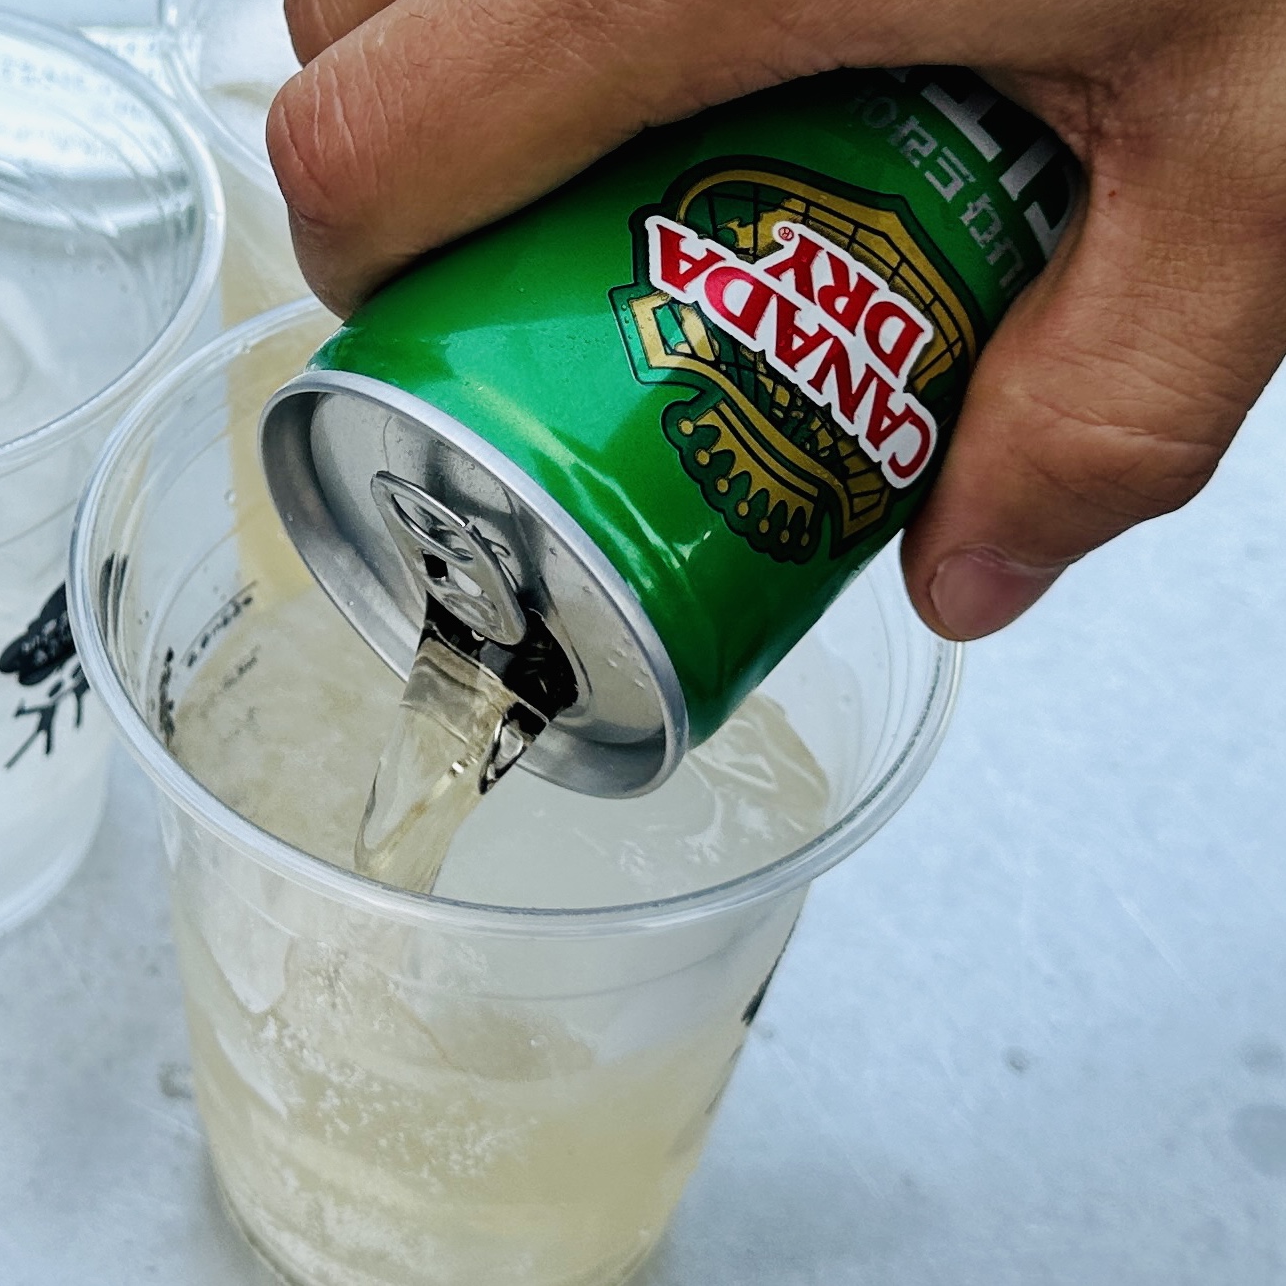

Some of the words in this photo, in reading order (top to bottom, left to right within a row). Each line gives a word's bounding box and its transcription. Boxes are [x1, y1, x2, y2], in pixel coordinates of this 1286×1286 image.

[765, 230, 924, 380] DRY
[959, 193, 1026, 295] 나다
[656, 223, 932, 480] CANADA
